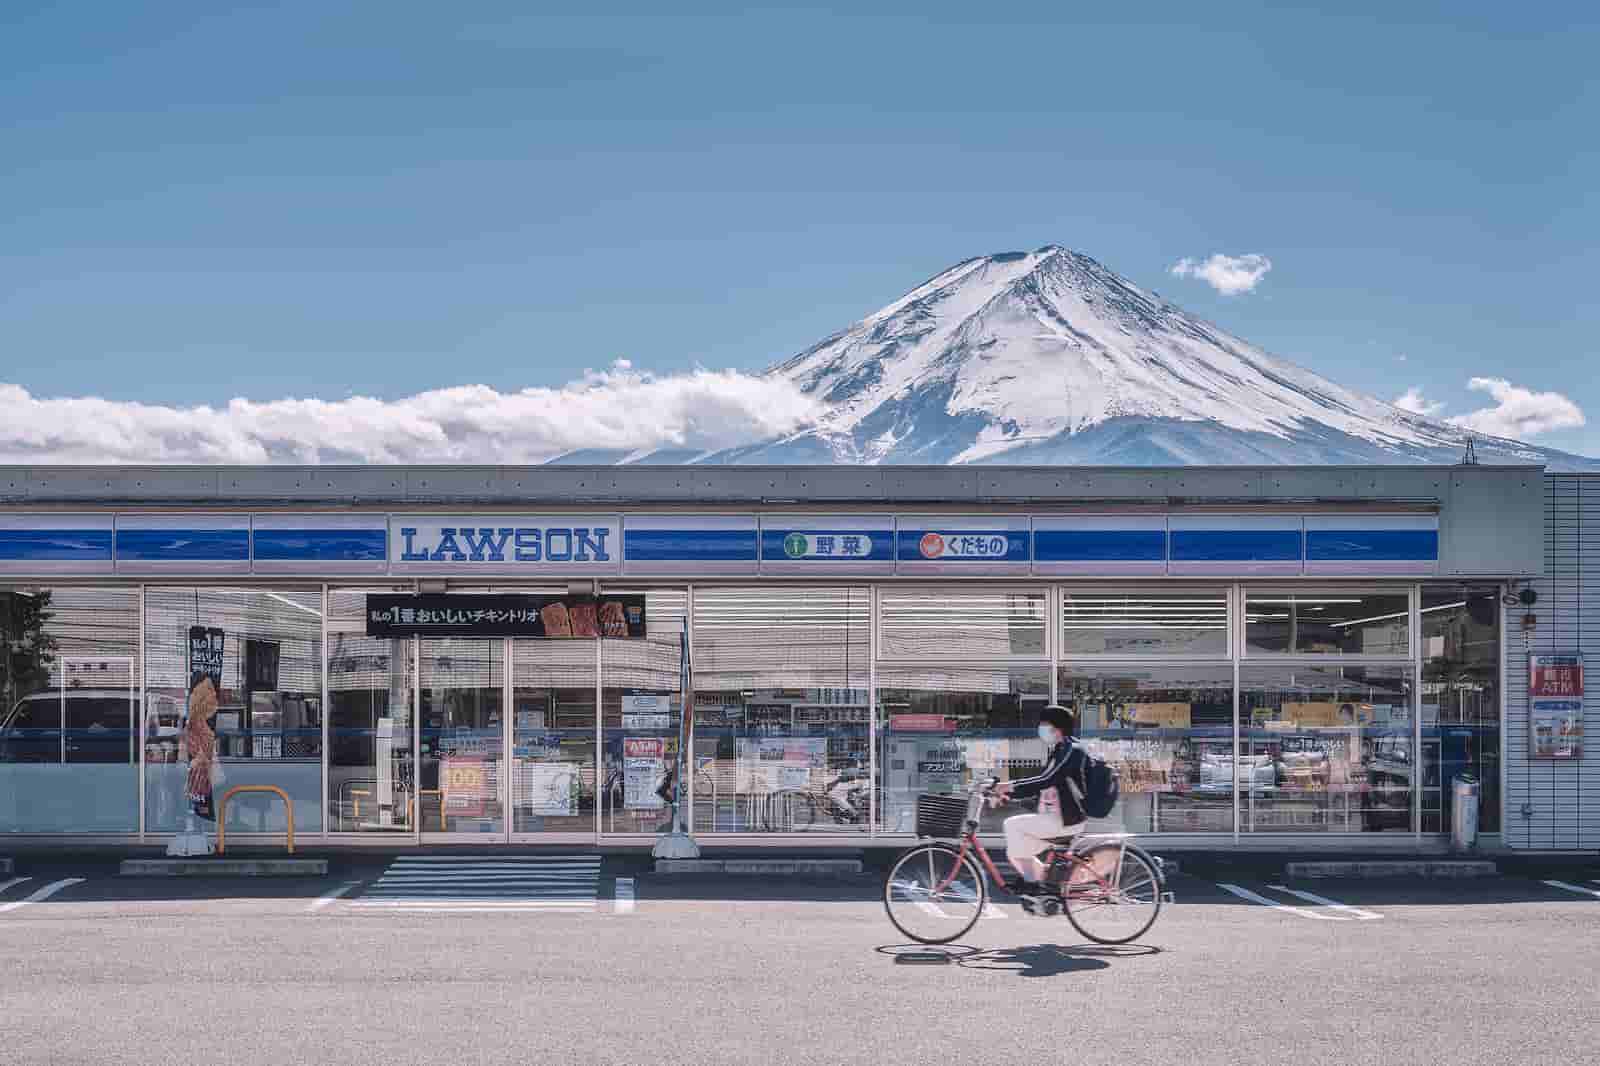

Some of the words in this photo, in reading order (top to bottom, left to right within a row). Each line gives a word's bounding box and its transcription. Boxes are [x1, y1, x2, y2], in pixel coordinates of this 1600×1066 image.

[401, 528, 609, 561] LAWSON
[816, 536, 862, 555] 野菜
[948, 536, 1003, 553] くだもの
